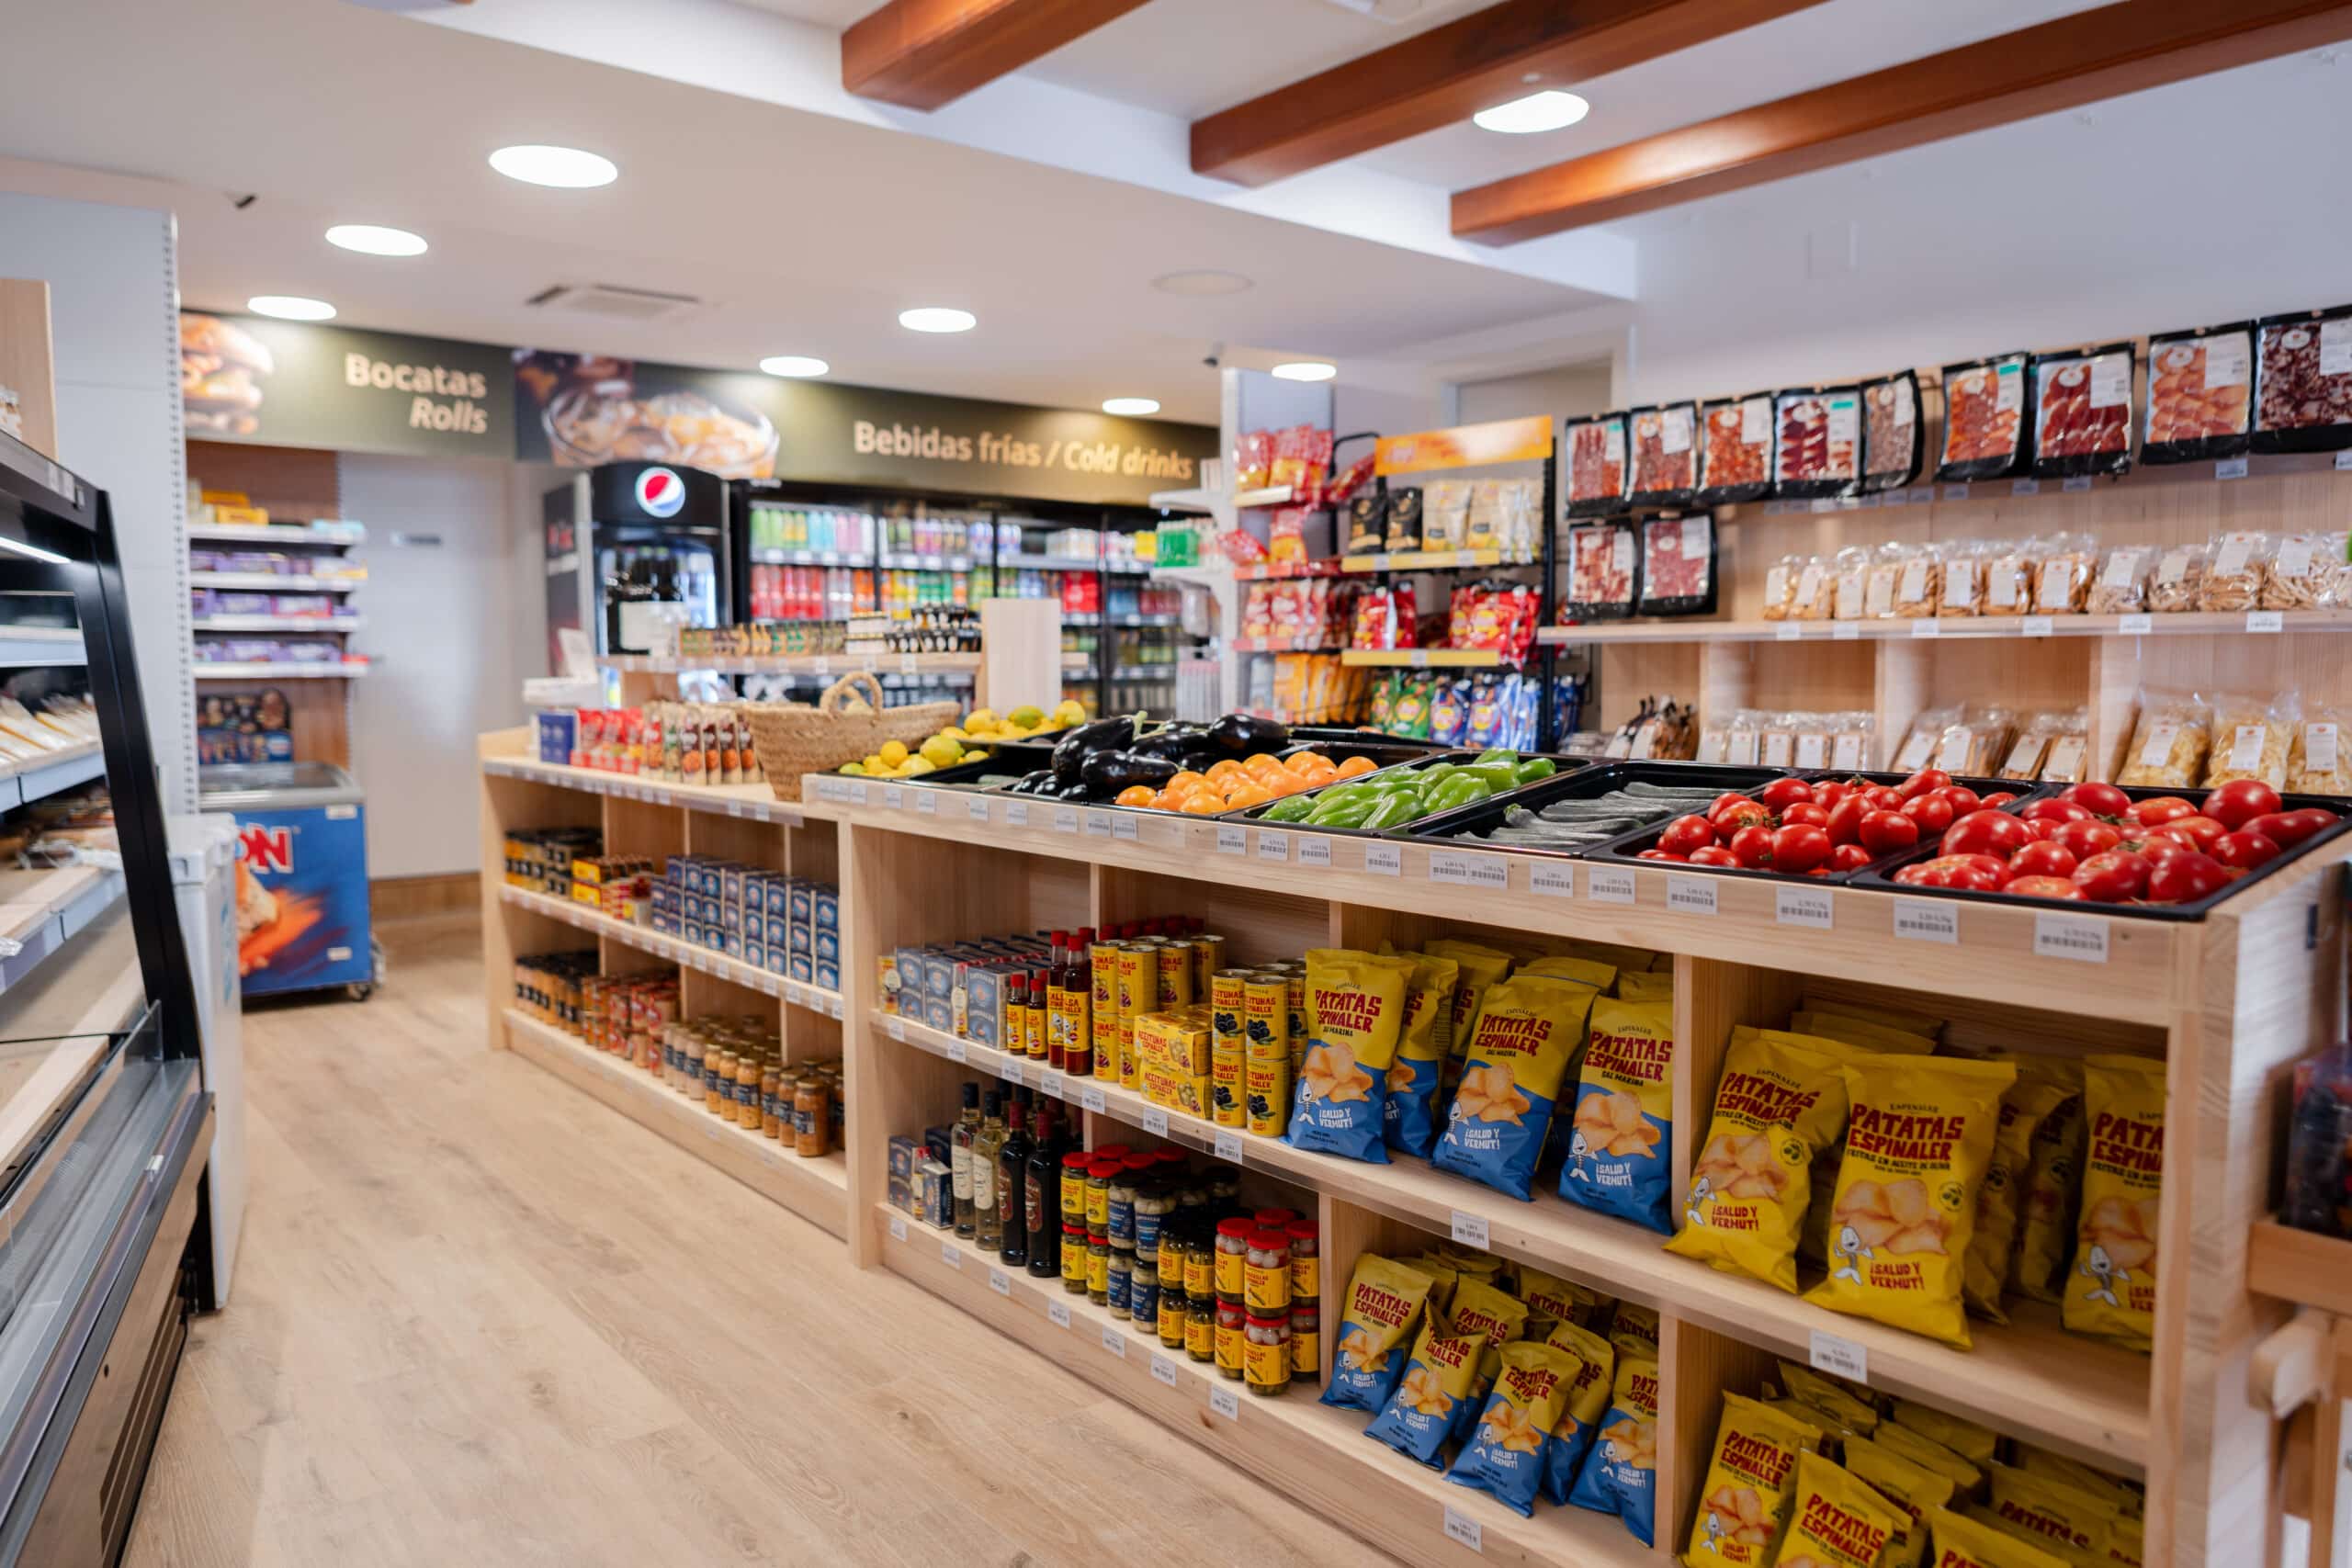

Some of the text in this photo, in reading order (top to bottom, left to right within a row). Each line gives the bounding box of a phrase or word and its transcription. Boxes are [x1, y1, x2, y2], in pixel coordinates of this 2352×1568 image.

[345, 353, 487, 398] Bocatas
[410, 397, 487, 434] Rolls
[854, 421, 972, 461] Bebidas
[978, 431, 1043, 467] frías
[1063, 441, 1121, 473] Cold
[1123, 447, 1193, 479] drinks
[1315, 989, 1382, 1017] PATATAS
[1480, 1013, 1553, 1041] PATATAS
[1474, 1032, 1540, 1056] ESPINALER
[1588, 1030, 1673, 1063] PATATAS
[1584, 1050, 1665, 1082] ESPINALER
[1601, 1070, 1613, 1078] SAL
[1721, 1072, 1822, 1109] PATATAS
[1344, 1107, 1351, 1117] Y
[1716, 1093, 1802, 1122] ESPINALER
[1850, 1102, 1966, 1141] PATATAS
[1319, 1117, 1353, 1129] VERMUT!
[1493, 1127, 1499, 1138] Y
[1464, 1138, 1500, 1150] VERMUT!
[1849, 1127, 1953, 1161] ESPINALER
[1624, 1161, 1632, 1174] Y
[1878, 1156, 1890, 1166] EN
[1595, 1174, 1633, 1187] VERMUT!
[1712, 1204, 1758, 1218] ¡SALUD Y
[1712, 1216, 1759, 1232] VERMUT!
[1870, 1261, 1921, 1276] ¡SALUD Y
[1870, 1275, 1926, 1291] VERMUT!
[1355, 1281, 1412, 1318] PATATAS
[1352, 1300, 1404, 1329] ESPINALER
[1724, 1429, 1795, 1473] PATATAS
[1720, 1447, 1784, 1486] ESPINALER
[1805, 1493, 1886, 1551] PATATAS
[1801, 1513, 1874, 1564] ESPINALER
